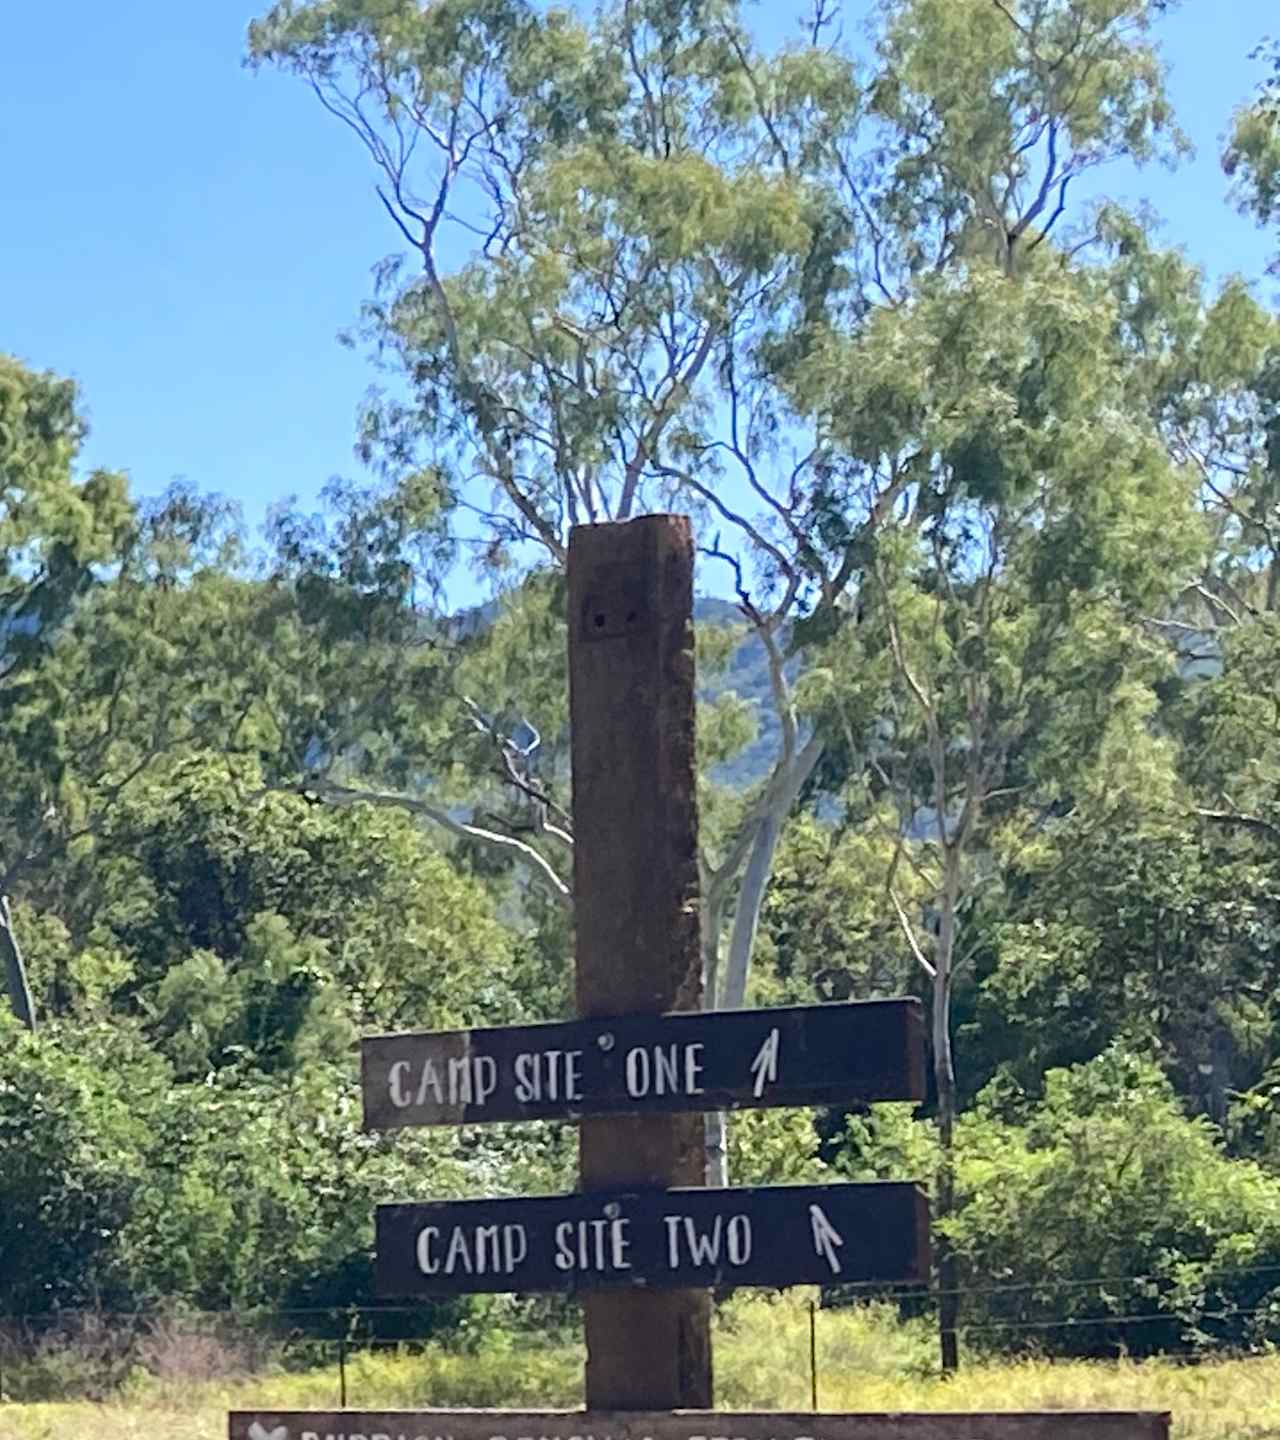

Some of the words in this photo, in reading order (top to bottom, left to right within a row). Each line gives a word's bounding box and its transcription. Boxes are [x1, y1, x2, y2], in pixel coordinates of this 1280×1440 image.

[388, 1056, 497, 1107] CAMP
[514, 1050, 583, 1101] SITE
[626, 1043, 704, 1099] ONE
[416, 1224, 527, 1275] CAMP
[555, 1217, 632, 1270] SITE
[665, 1213, 752, 1268] TWO
